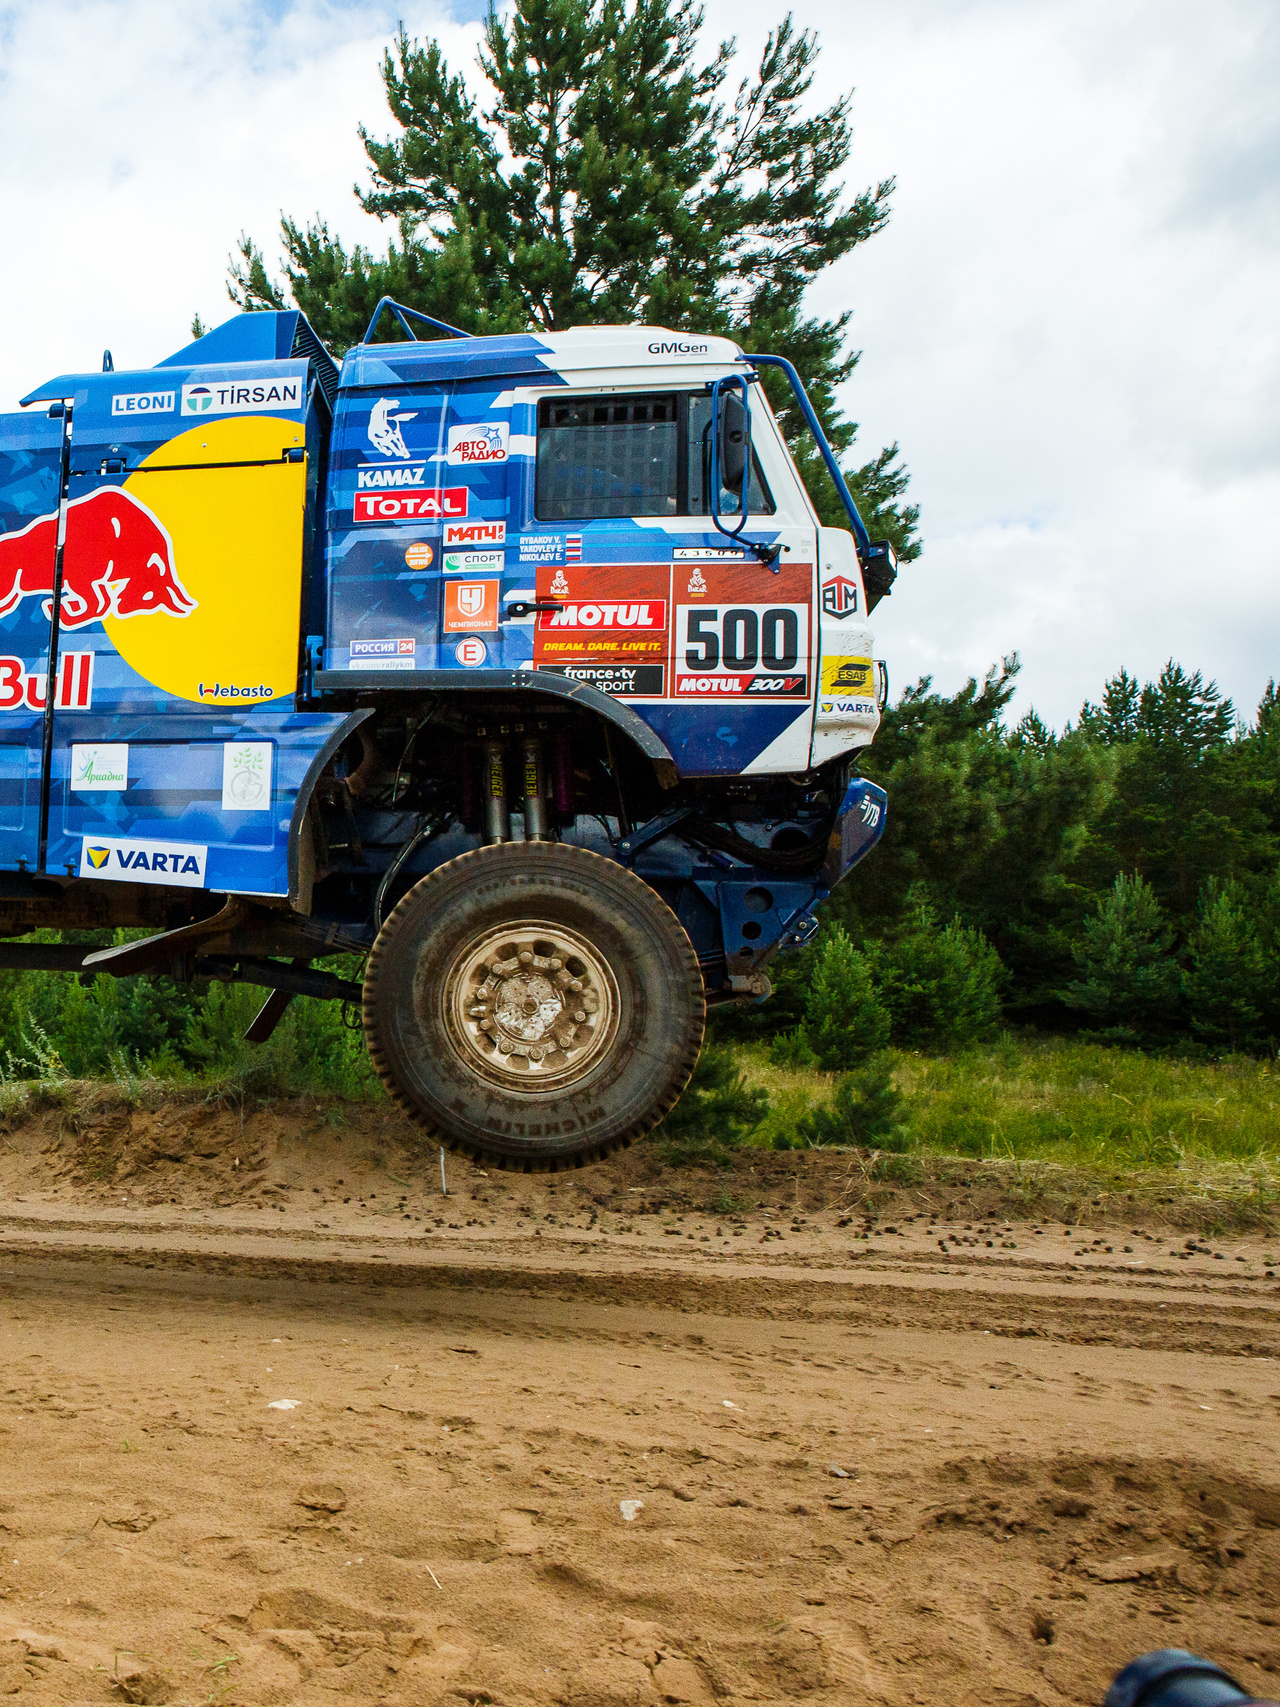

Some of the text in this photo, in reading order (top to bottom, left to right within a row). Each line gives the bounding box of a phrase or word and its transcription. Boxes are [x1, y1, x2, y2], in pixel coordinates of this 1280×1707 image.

[648, 342, 708, 354] GMGen
[115, 395, 172, 411] LEONI
[452, 440, 487, 452] АВТО
[462, 449, 506, 461] РАДИО
[358, 468, 425, 488] KAMAZ
[359, 496, 462, 516] TOTAL
[520, 536, 553, 545] RYBAKOV
[519, 545, 556, 553] YAKOVLEV
[465, 554, 502, 563] СПОРТ
[519, 553, 555, 562] NIKOLAEV
[550, 604, 653, 626] MOTUL
[449, 620, 493, 629] ЧЕМПИОНАТ
[685, 609, 798, 671] 500
[355, 643, 413, 653] РОССИЯ 24
[463, 644, 477, 661] E
[543, 642, 661, 651] DREAM. DARE. LIVE IT.
[838, 670, 866, 681] ESAB
[596, 679, 635, 693] sport
[679, 678, 804, 691] MOTUL 300V
[199, 683, 273, 699] Webasto
[836, 703, 875, 713] VARTA
[75, 760, 124, 785] Ариадна
[116, 850, 200, 875] VARTA
